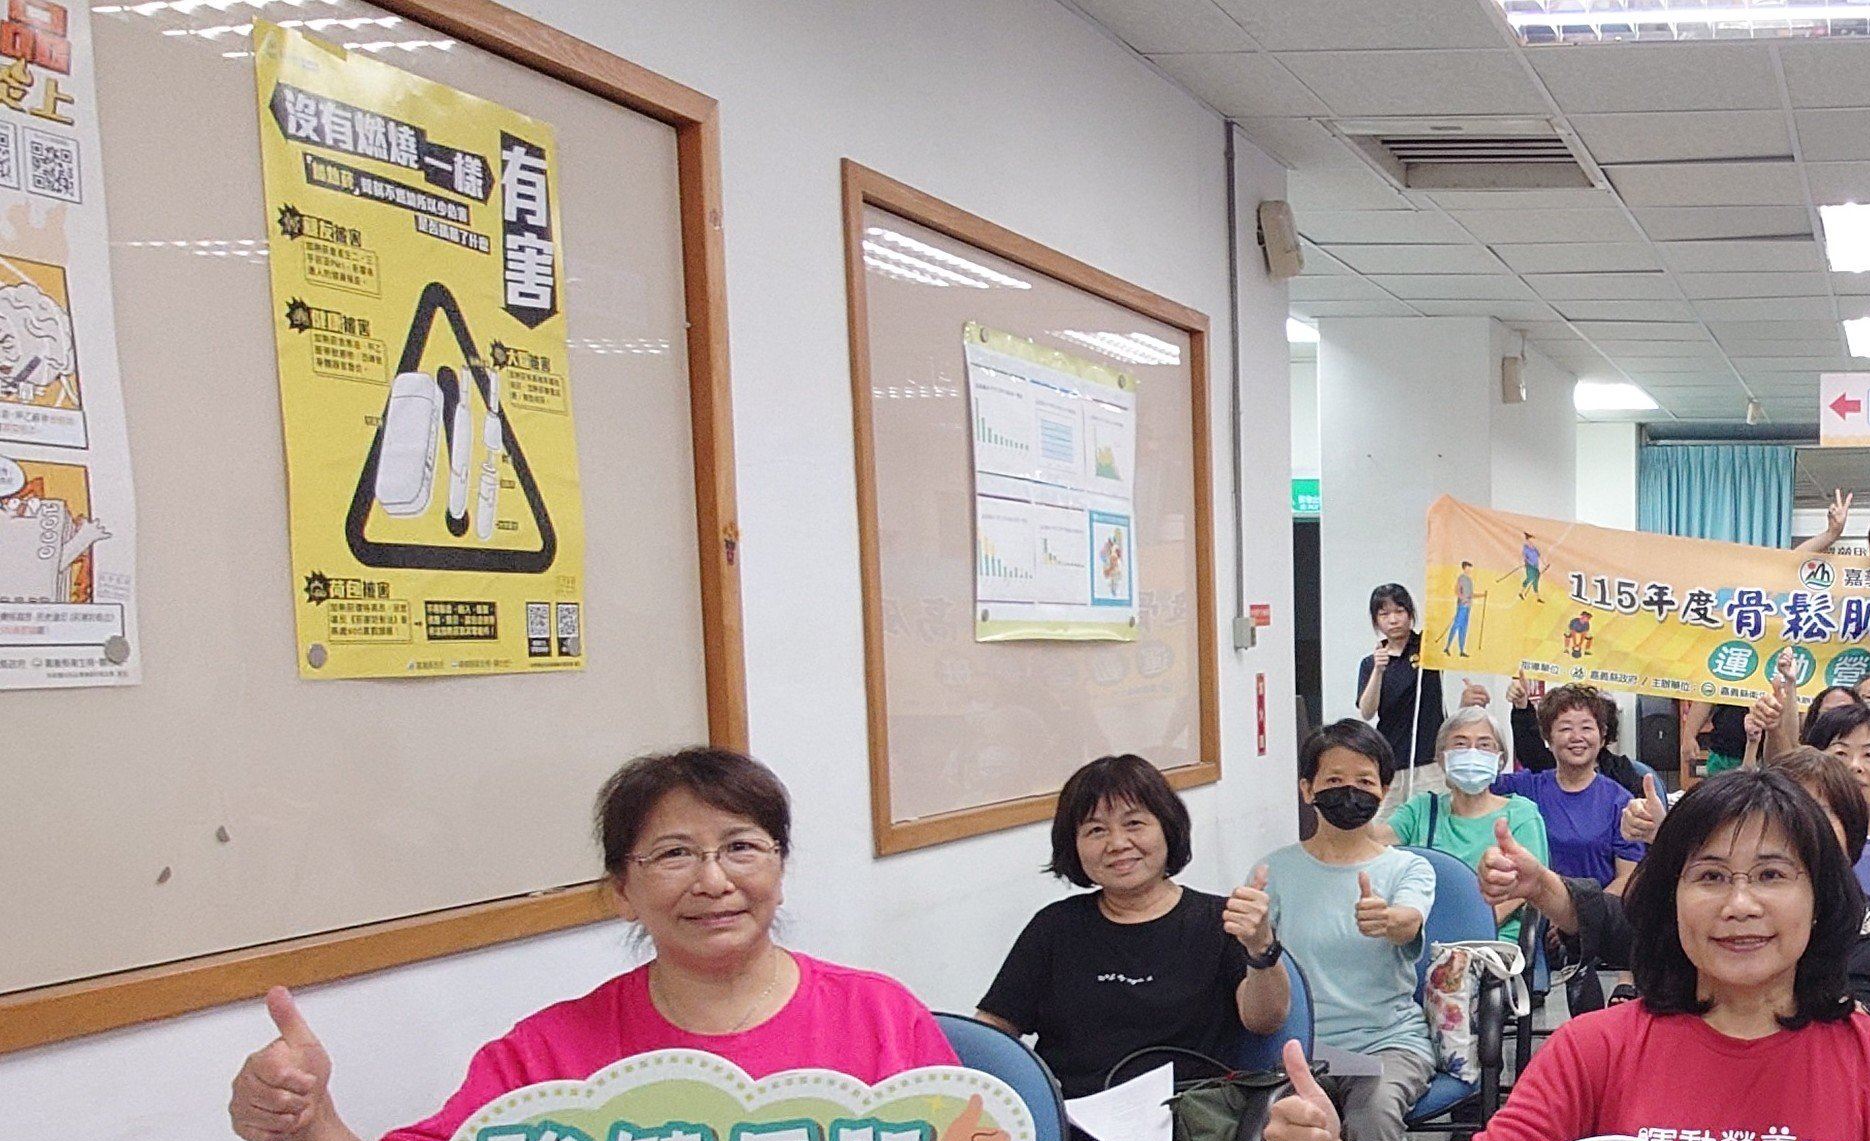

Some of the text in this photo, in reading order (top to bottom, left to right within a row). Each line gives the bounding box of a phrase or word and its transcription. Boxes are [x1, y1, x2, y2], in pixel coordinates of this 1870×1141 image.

[284, 88, 485, 201] 沒有燃燒一樣
[501, 145, 553, 310] 有害
